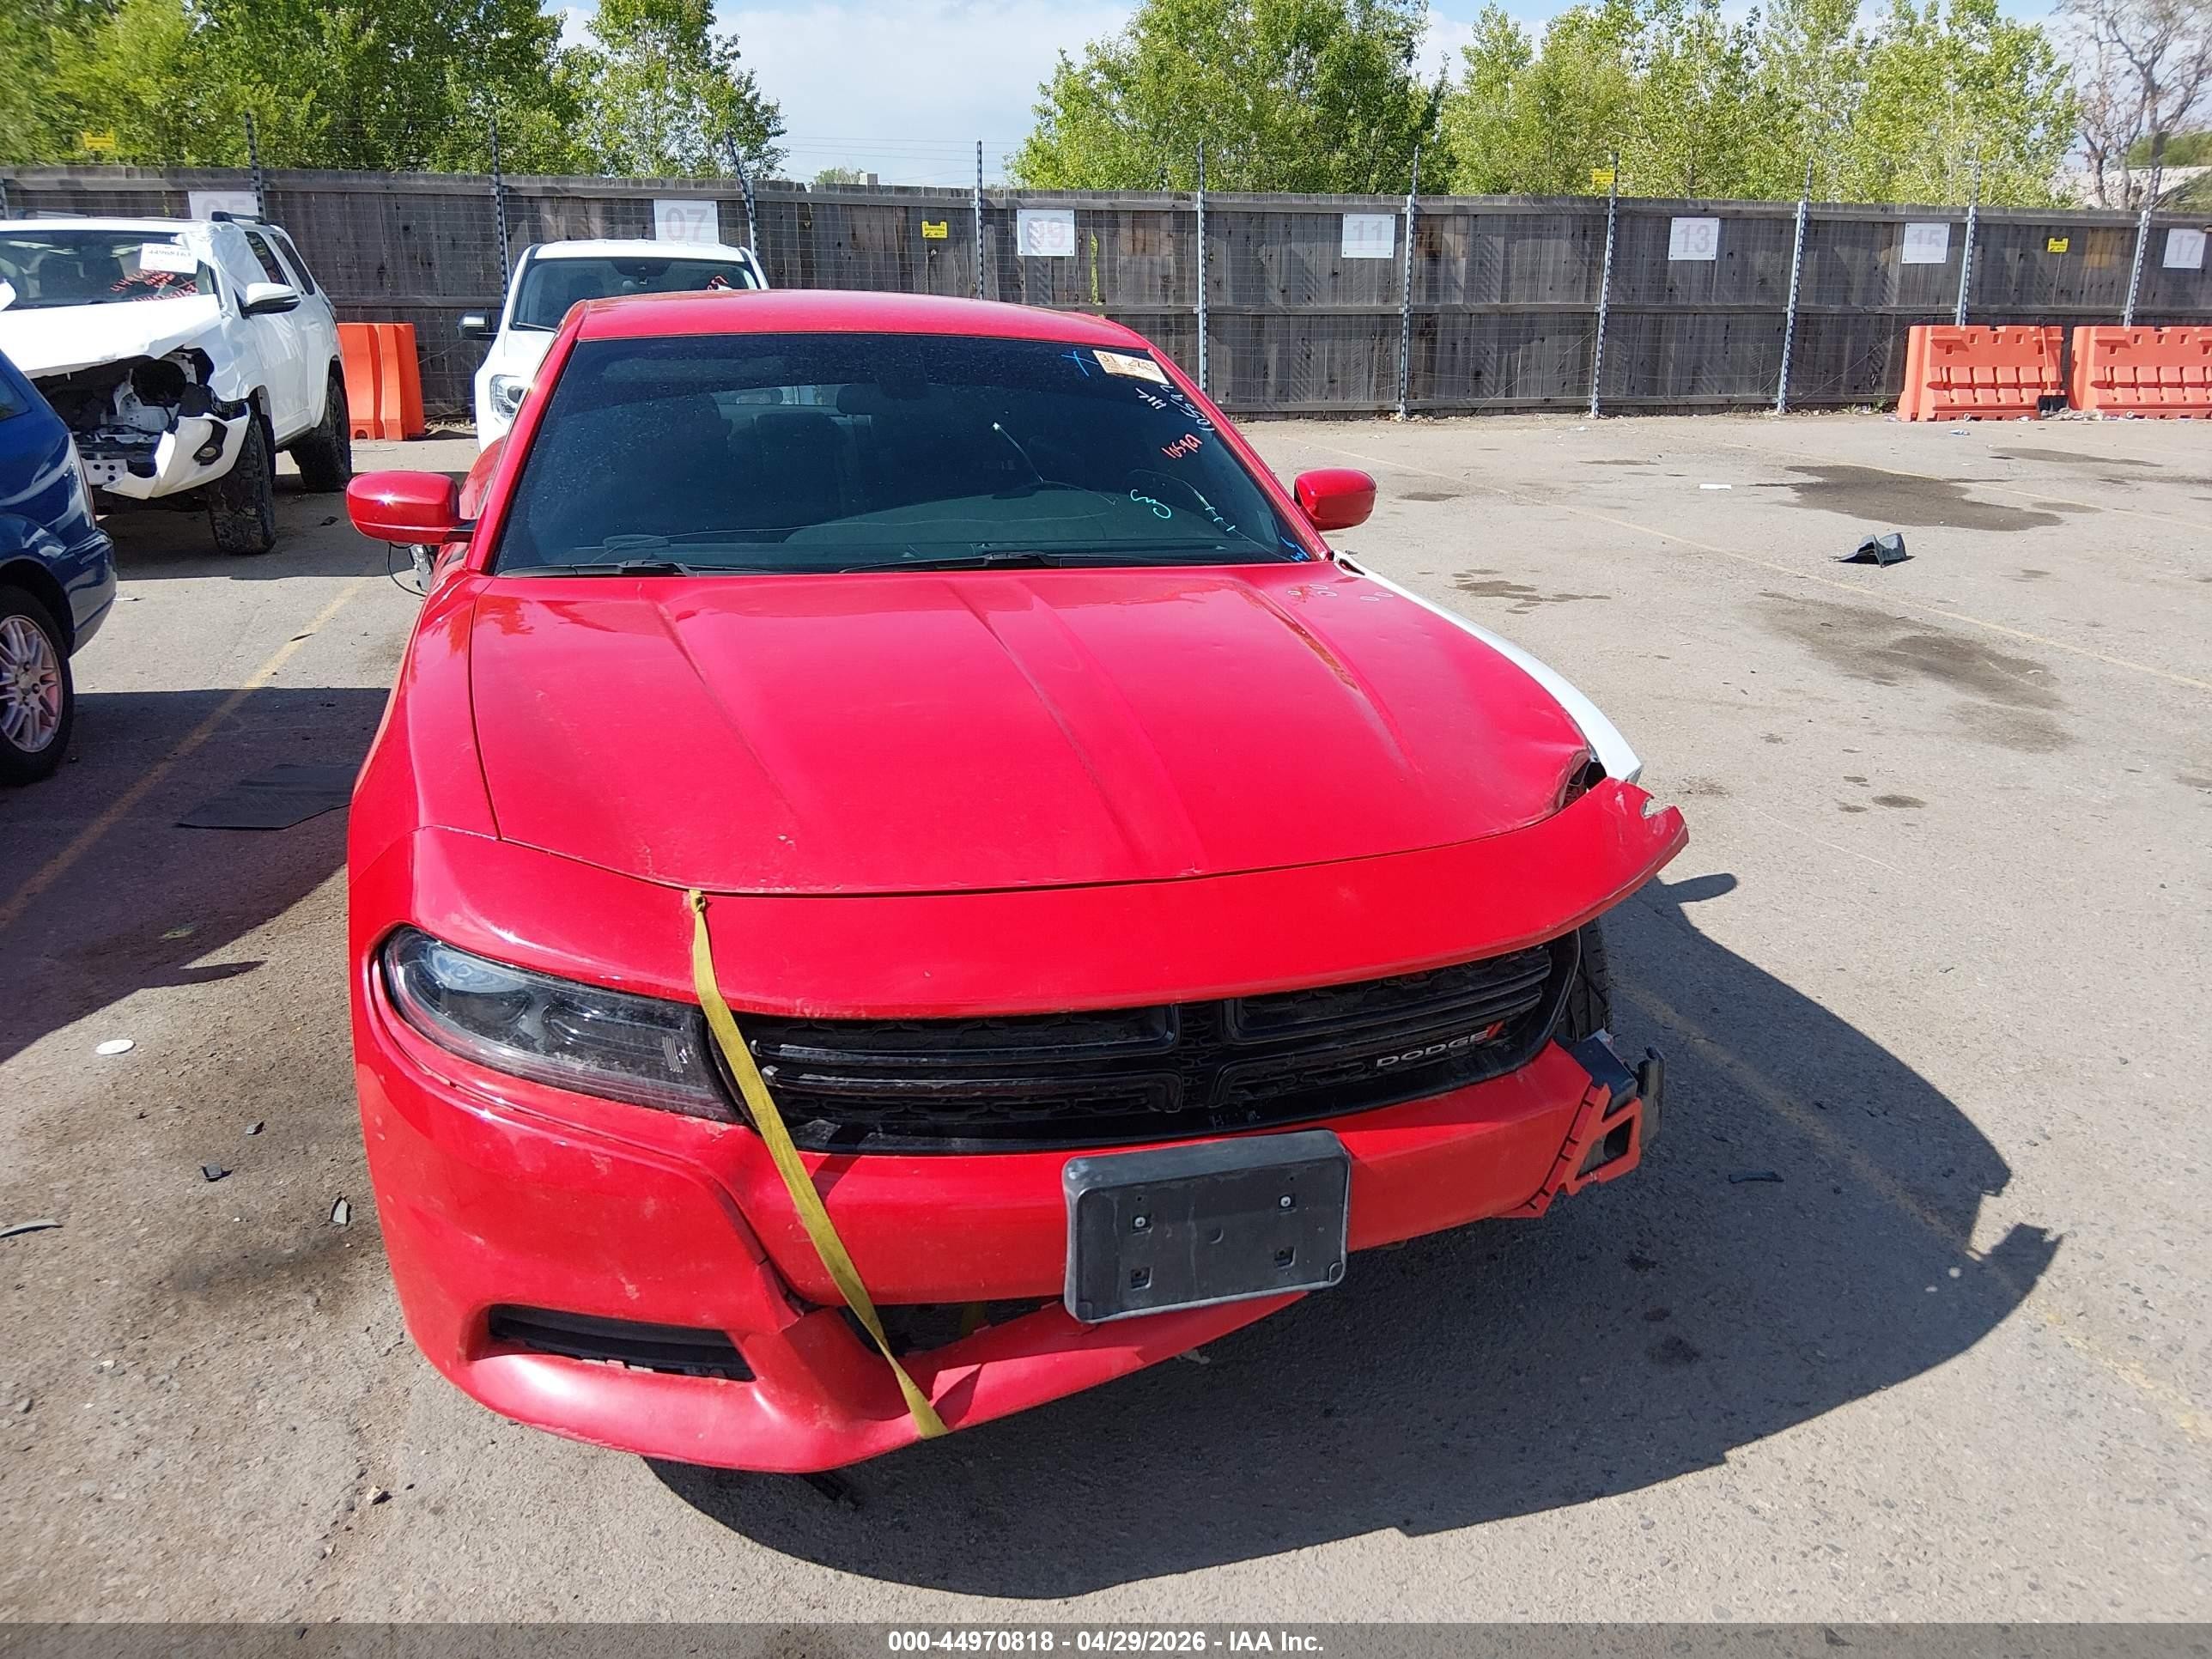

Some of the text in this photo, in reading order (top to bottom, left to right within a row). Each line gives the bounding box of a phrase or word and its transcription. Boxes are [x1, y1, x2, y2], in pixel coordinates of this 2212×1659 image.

[665, 207, 708, 241] 07
[1353, 220, 1382, 250] 11
[1680, 224, 1711, 253] 13
[2175, 234, 2201, 262] 17
[1376, 1030, 1489, 1067] DODGE
